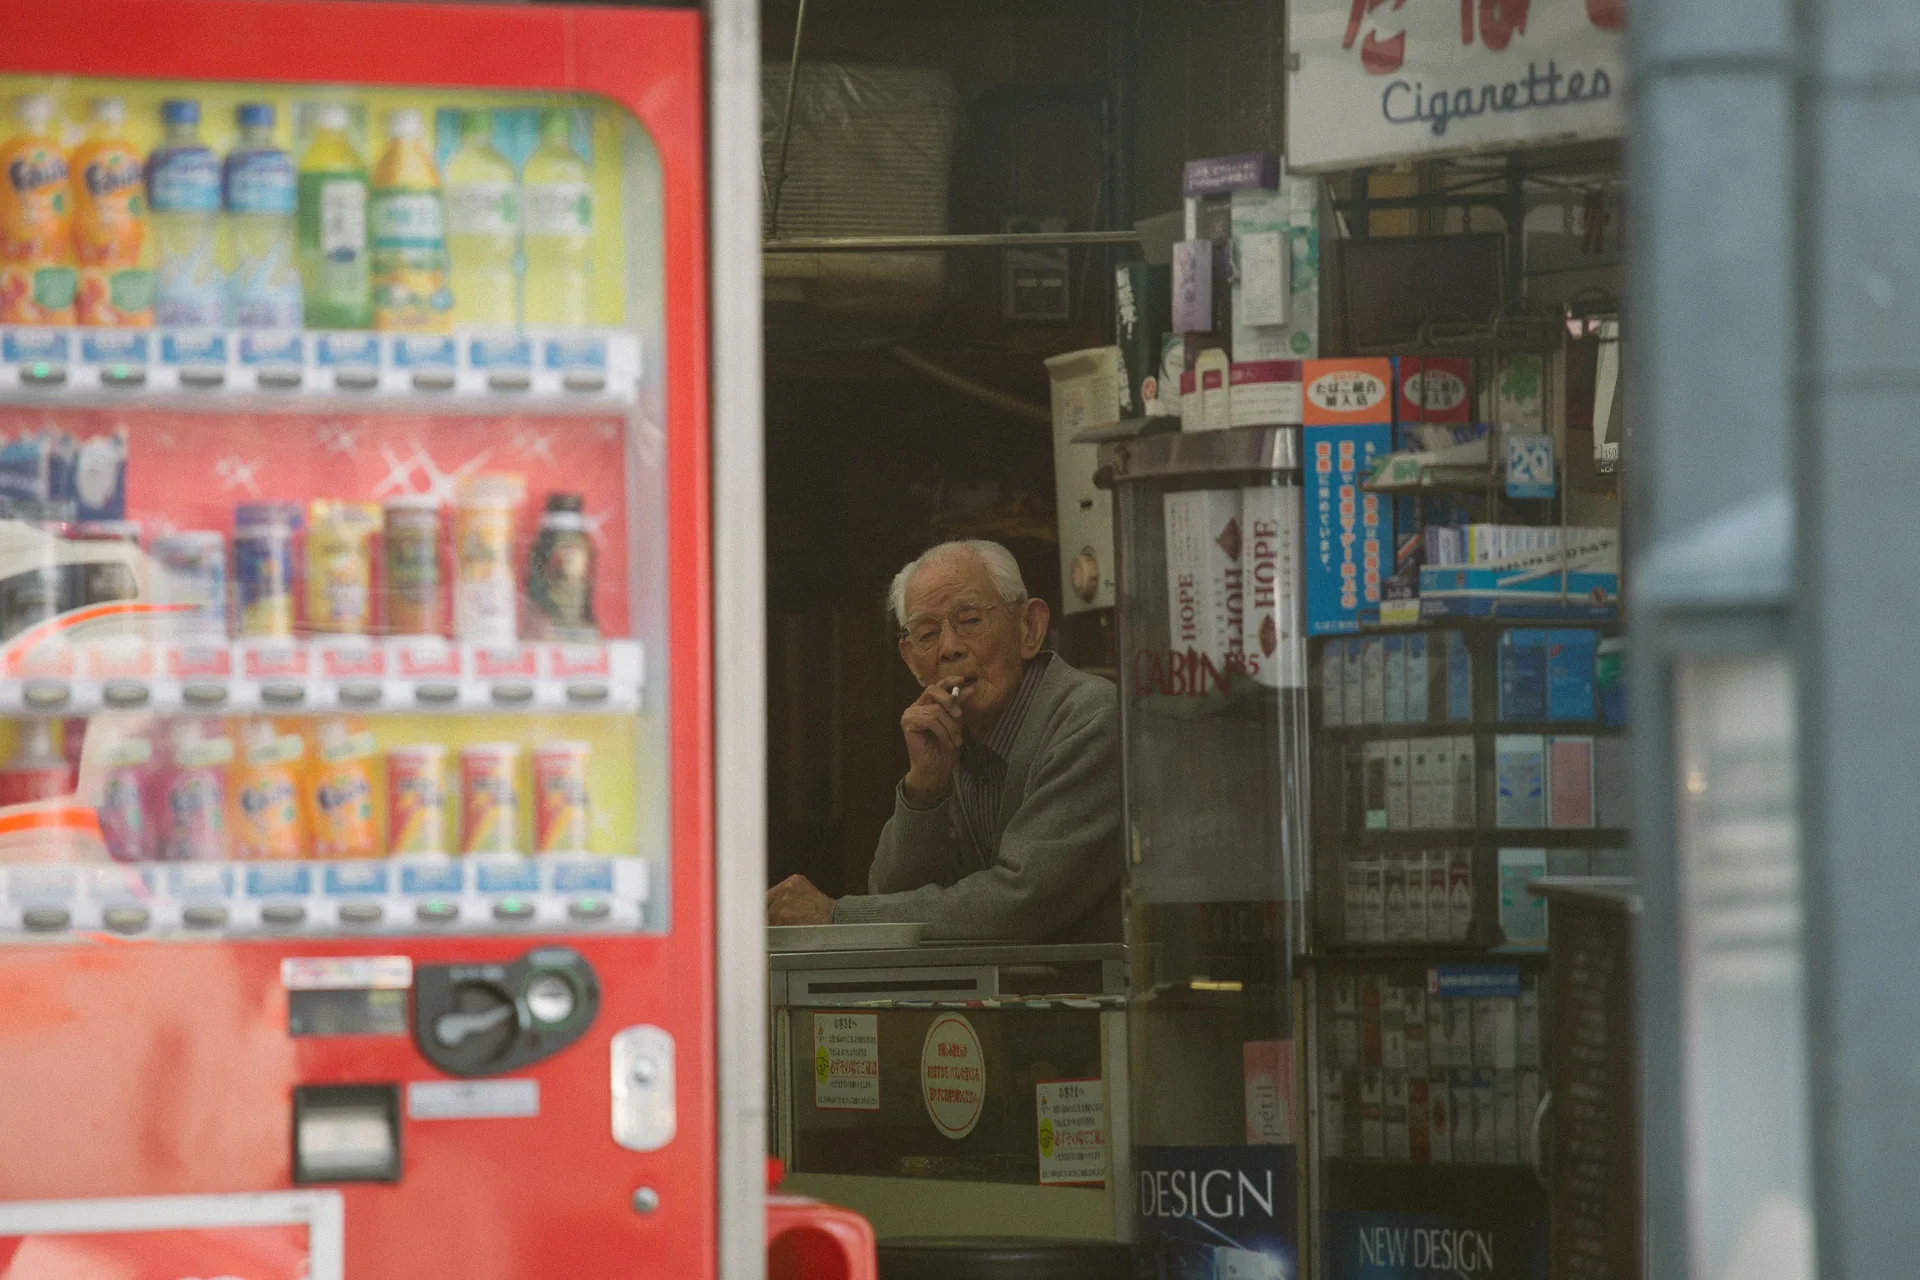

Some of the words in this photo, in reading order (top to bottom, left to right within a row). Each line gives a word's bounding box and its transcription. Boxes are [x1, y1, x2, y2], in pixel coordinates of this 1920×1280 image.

[1382, 60, 1611, 136] Cigarettes
[1254, 520, 1278, 609] HOPE
[1179, 572, 1197, 642] HOPE
[1133, 646, 1233, 697] CABIN
[1141, 1168, 1273, 1219] DESIGN
[1358, 1226, 1407, 1267] NEW
[1413, 1228, 1494, 1273] DESIGN
